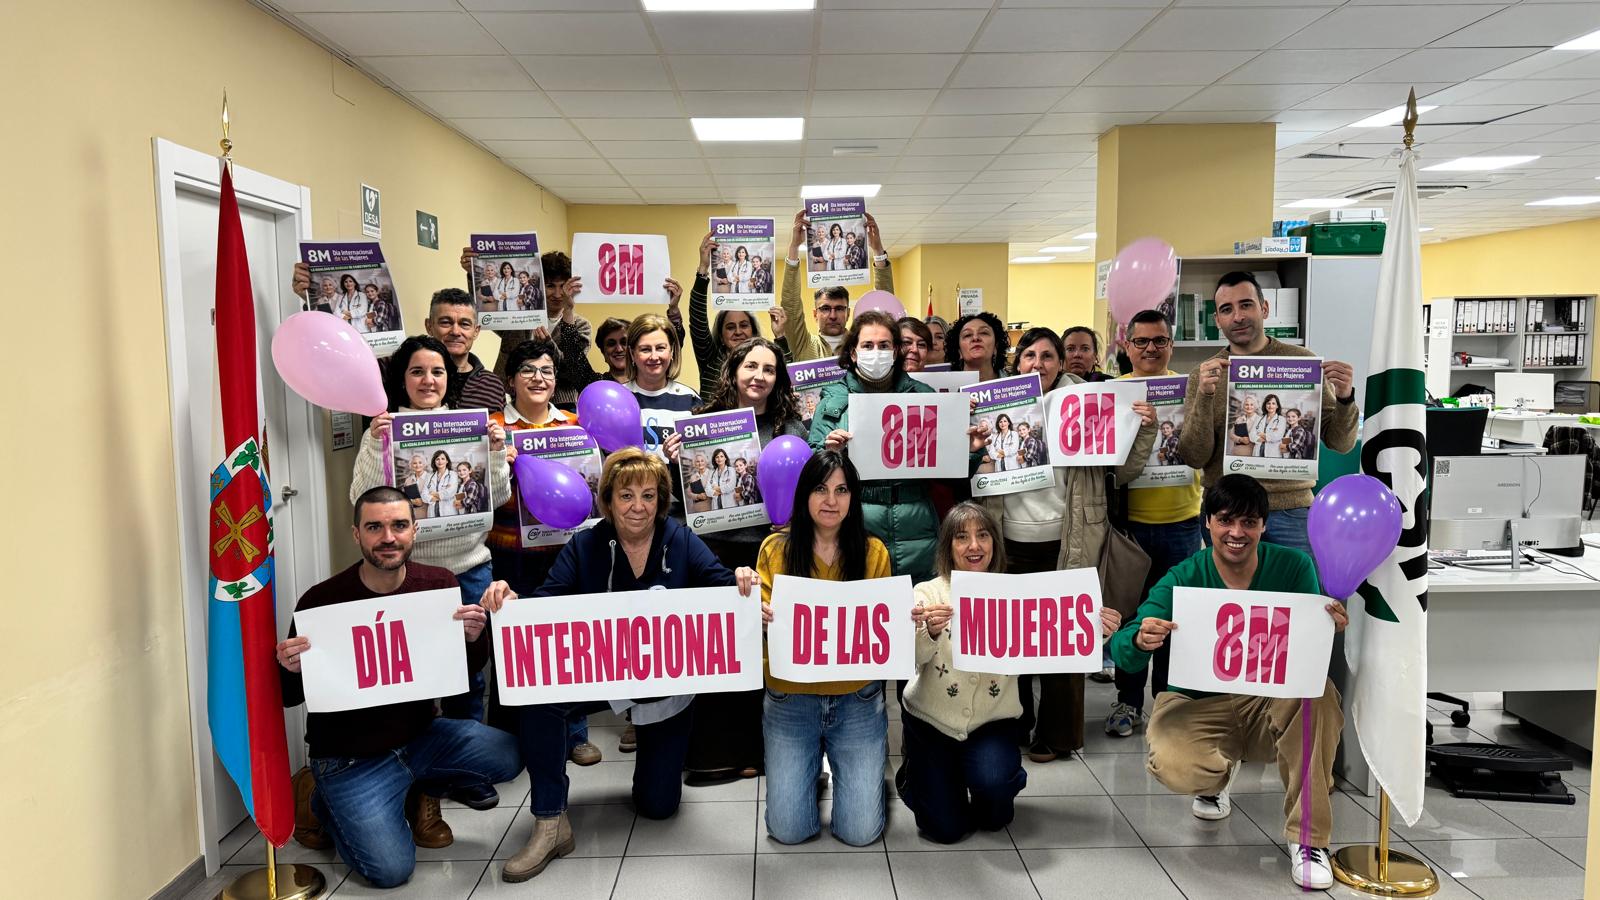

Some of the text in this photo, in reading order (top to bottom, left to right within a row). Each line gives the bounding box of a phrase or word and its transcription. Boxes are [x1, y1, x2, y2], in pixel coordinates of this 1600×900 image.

[811, 203, 828, 213] 8M
[365, 212, 378, 225] DESA
[717, 224, 734, 234] 8M
[477, 240, 496, 250] 8M
[308, 250, 331, 262] 8M
[598, 243, 644, 295] 8M
[795, 368, 815, 381] 8M
[1238, 366, 1264, 378] 8M
[1002, 383, 1032, 392] Internacional
[402, 422, 429, 436] 8M
[718, 418, 747, 427] Internacional
[1060, 393, 1115, 456] 8M
[684, 424, 708, 438] 8M
[881, 405, 937, 469] 8M
[523, 437, 546, 450] 8M
[960, 594, 1095, 658] MUJERES
[793, 603, 890, 665] DE LAS
[352, 610, 414, 689] DÍA
[502, 612, 741, 688] INTERNACIONAL
[1213, 603, 1291, 684] 8M
